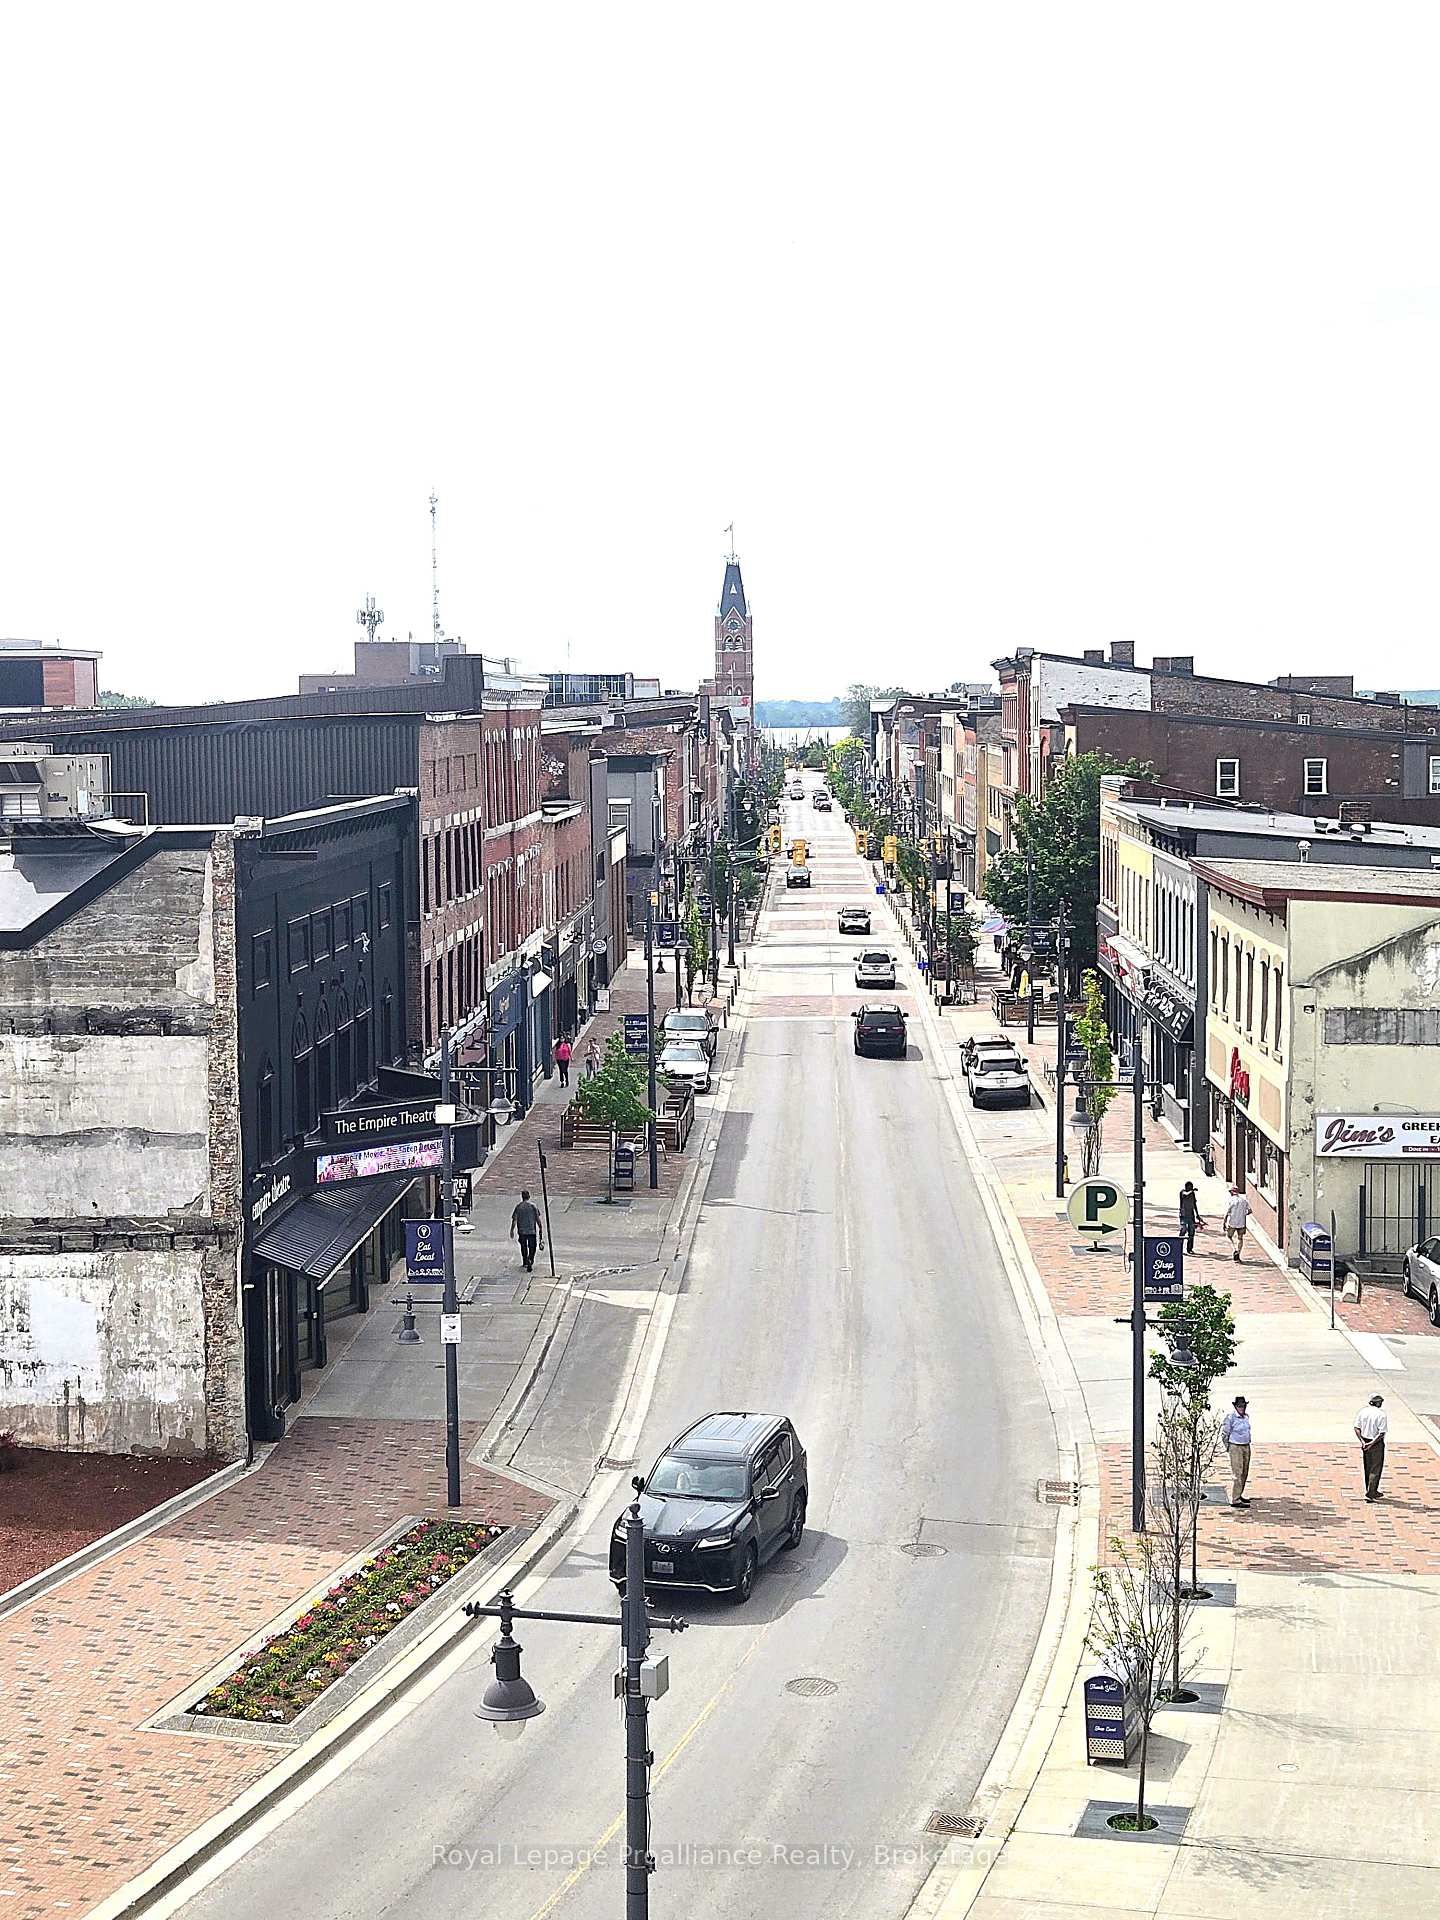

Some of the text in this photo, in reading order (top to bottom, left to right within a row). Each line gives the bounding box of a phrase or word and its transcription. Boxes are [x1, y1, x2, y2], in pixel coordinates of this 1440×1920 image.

[335, 1119, 357, 1134] The
[359, 1114, 397, 1132] Empire
[1321, 1118, 1396, 1152] Jim's
[1086, 1186, 1118, 1221] P
[417, 1241, 432, 1251] Eat
[414, 1252, 435, 1261] Local
[1152, 1260, 1175, 1270] Shop
[1152, 1270, 1175, 1280] Local
